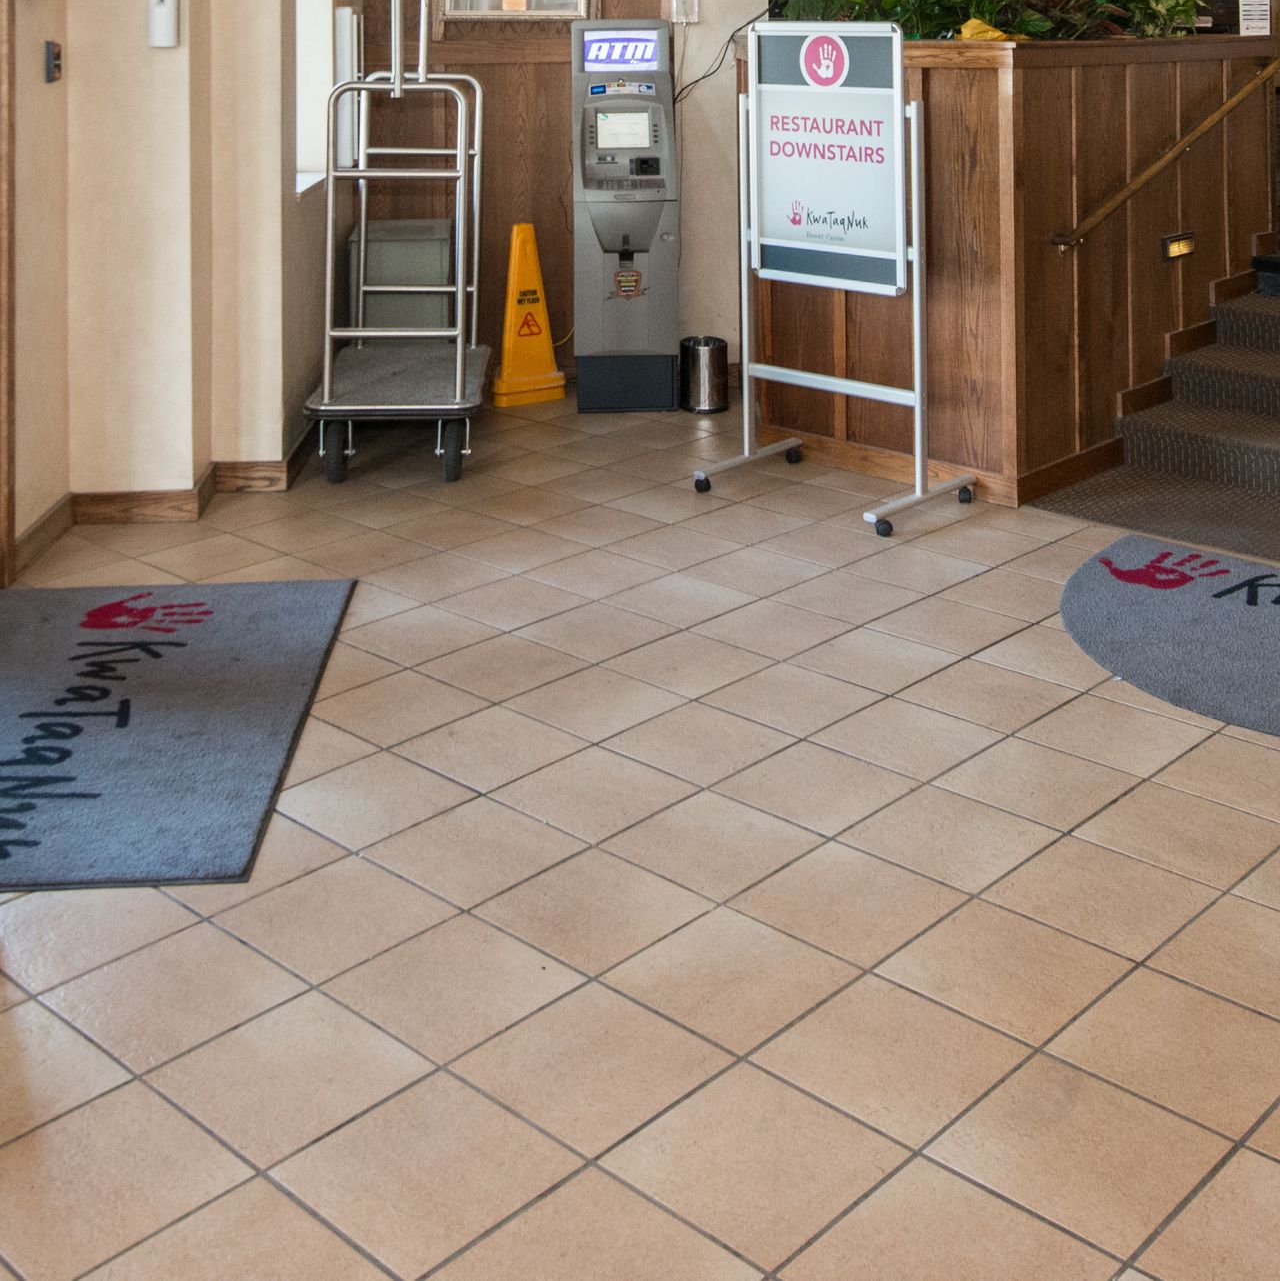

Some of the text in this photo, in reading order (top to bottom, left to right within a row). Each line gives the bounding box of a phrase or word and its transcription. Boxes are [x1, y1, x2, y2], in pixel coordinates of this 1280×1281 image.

[587, 41, 657, 61] ATM
[770, 115, 884, 138] RESTAURANT
[770, 140, 886, 165] DOWNSTAIRS
[806, 207, 869, 235] KwaTaqNuk
